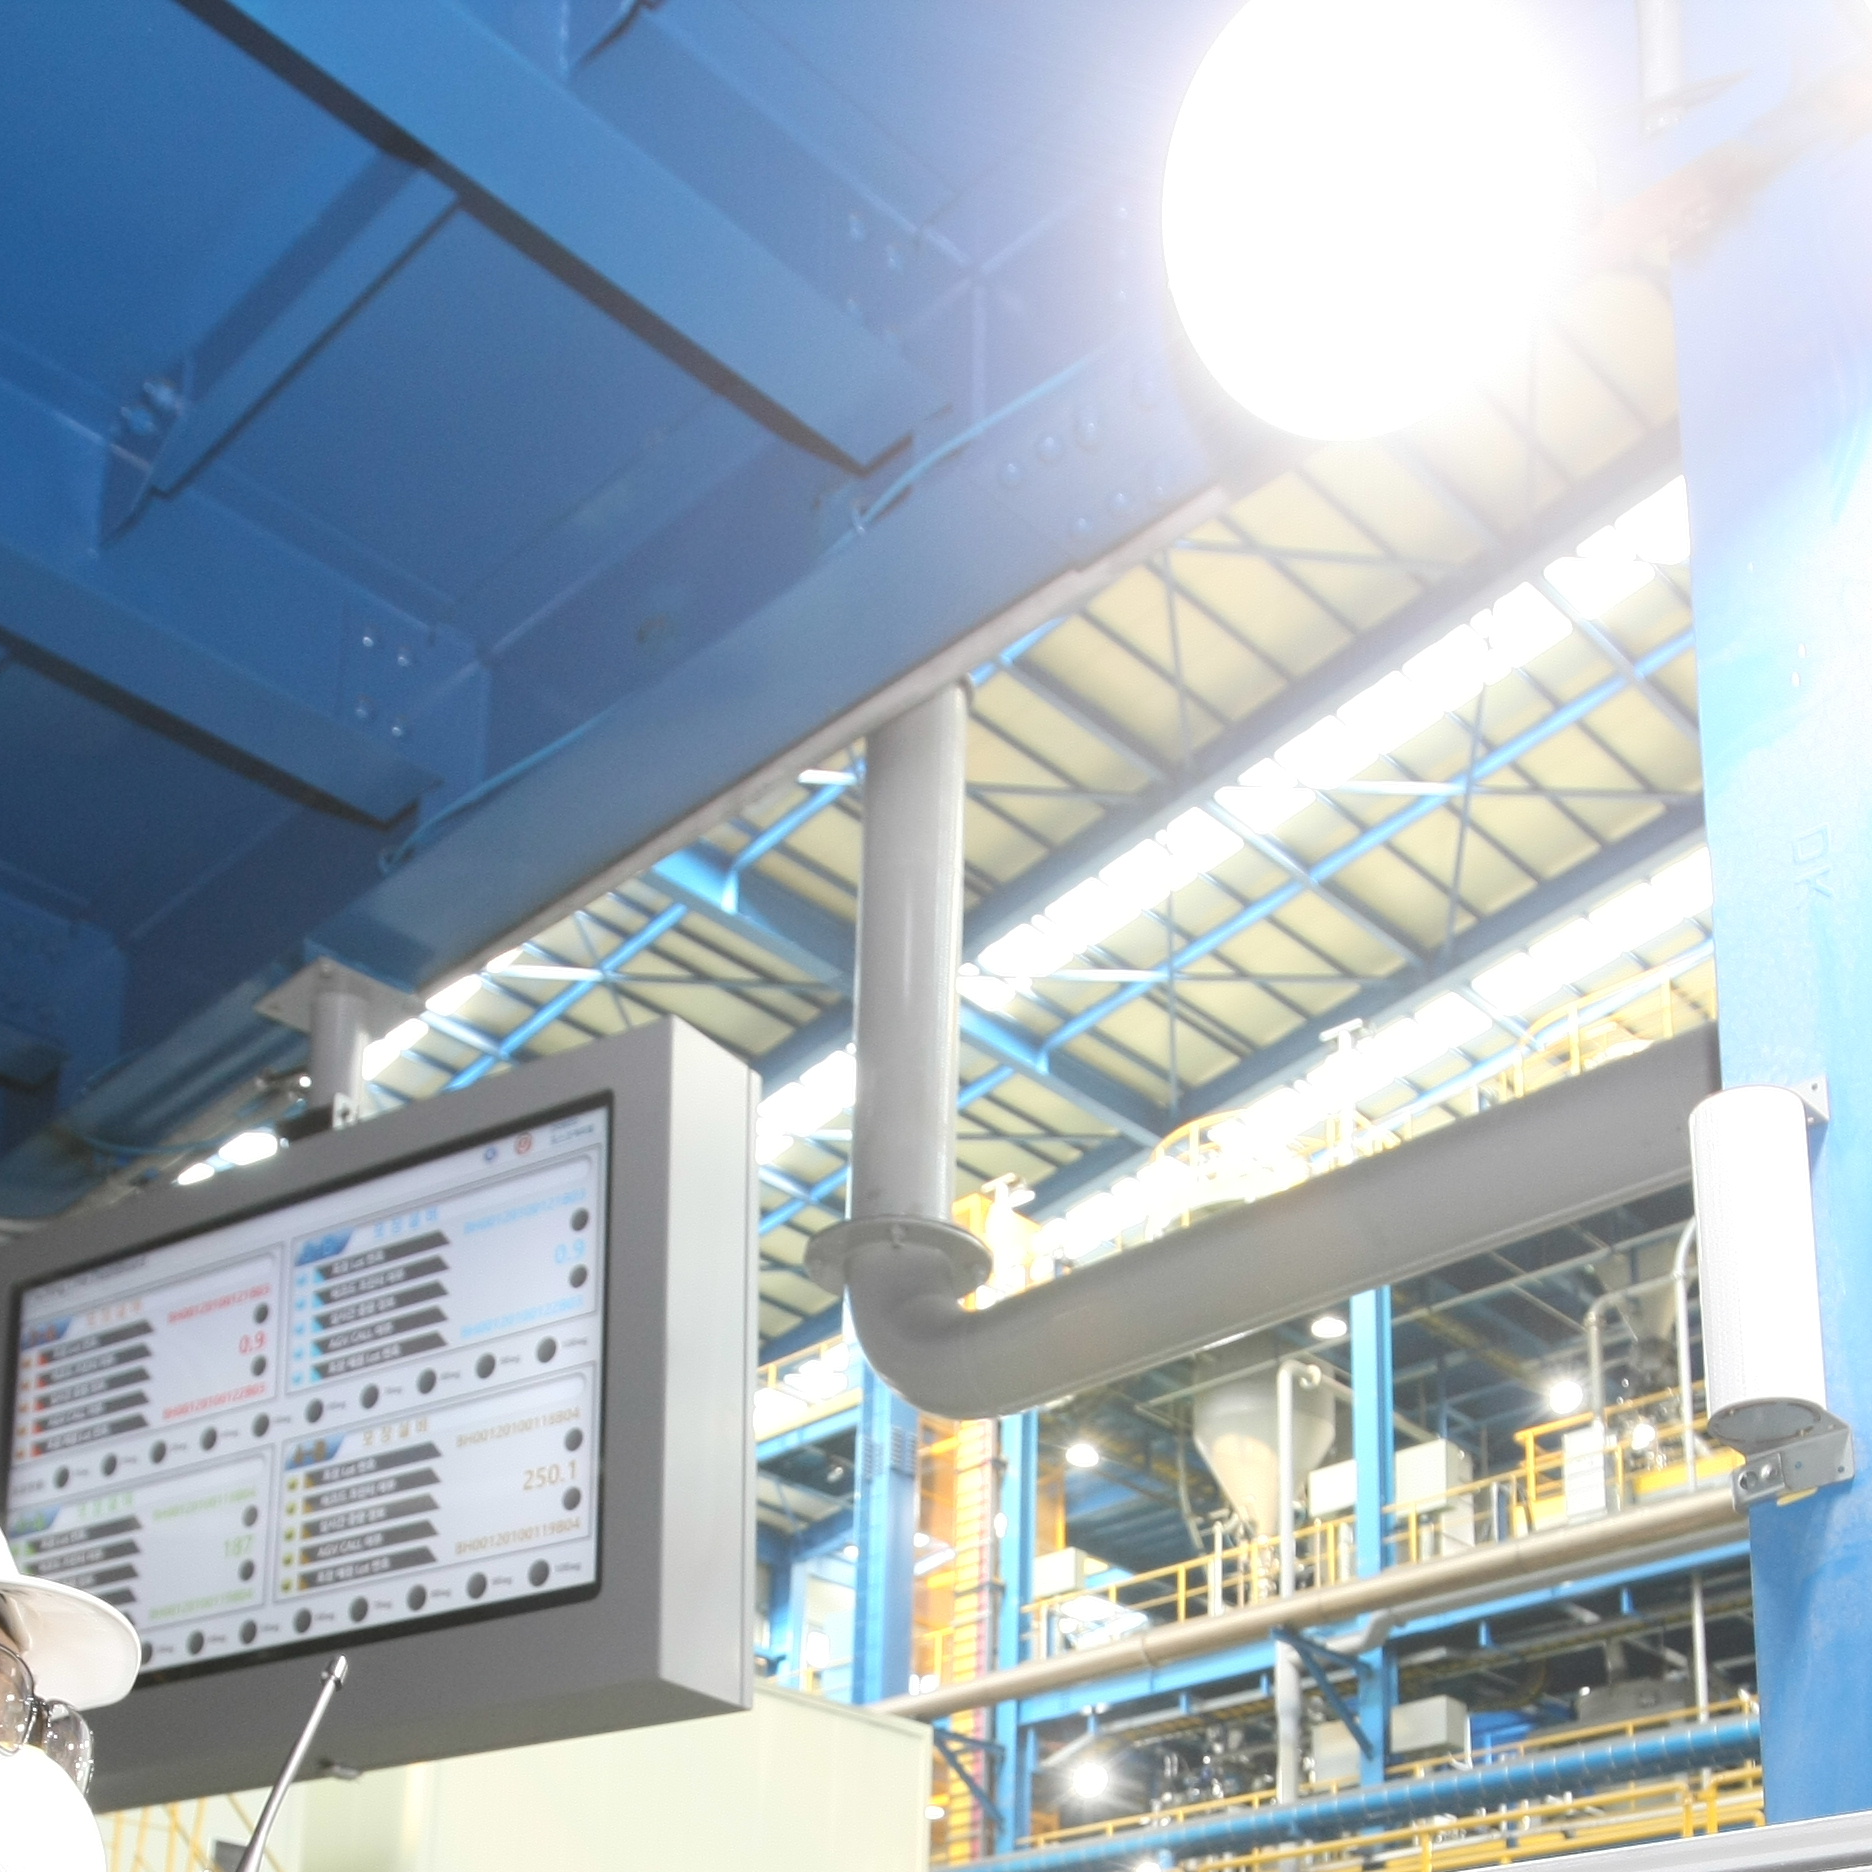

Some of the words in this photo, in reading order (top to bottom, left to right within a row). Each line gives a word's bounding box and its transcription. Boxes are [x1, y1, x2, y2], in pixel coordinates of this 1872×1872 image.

[554, 1238, 587, 1265] 0.9
[239, 1330, 267, 1355] 0.9
[522, 1459, 579, 1492] 250.1
